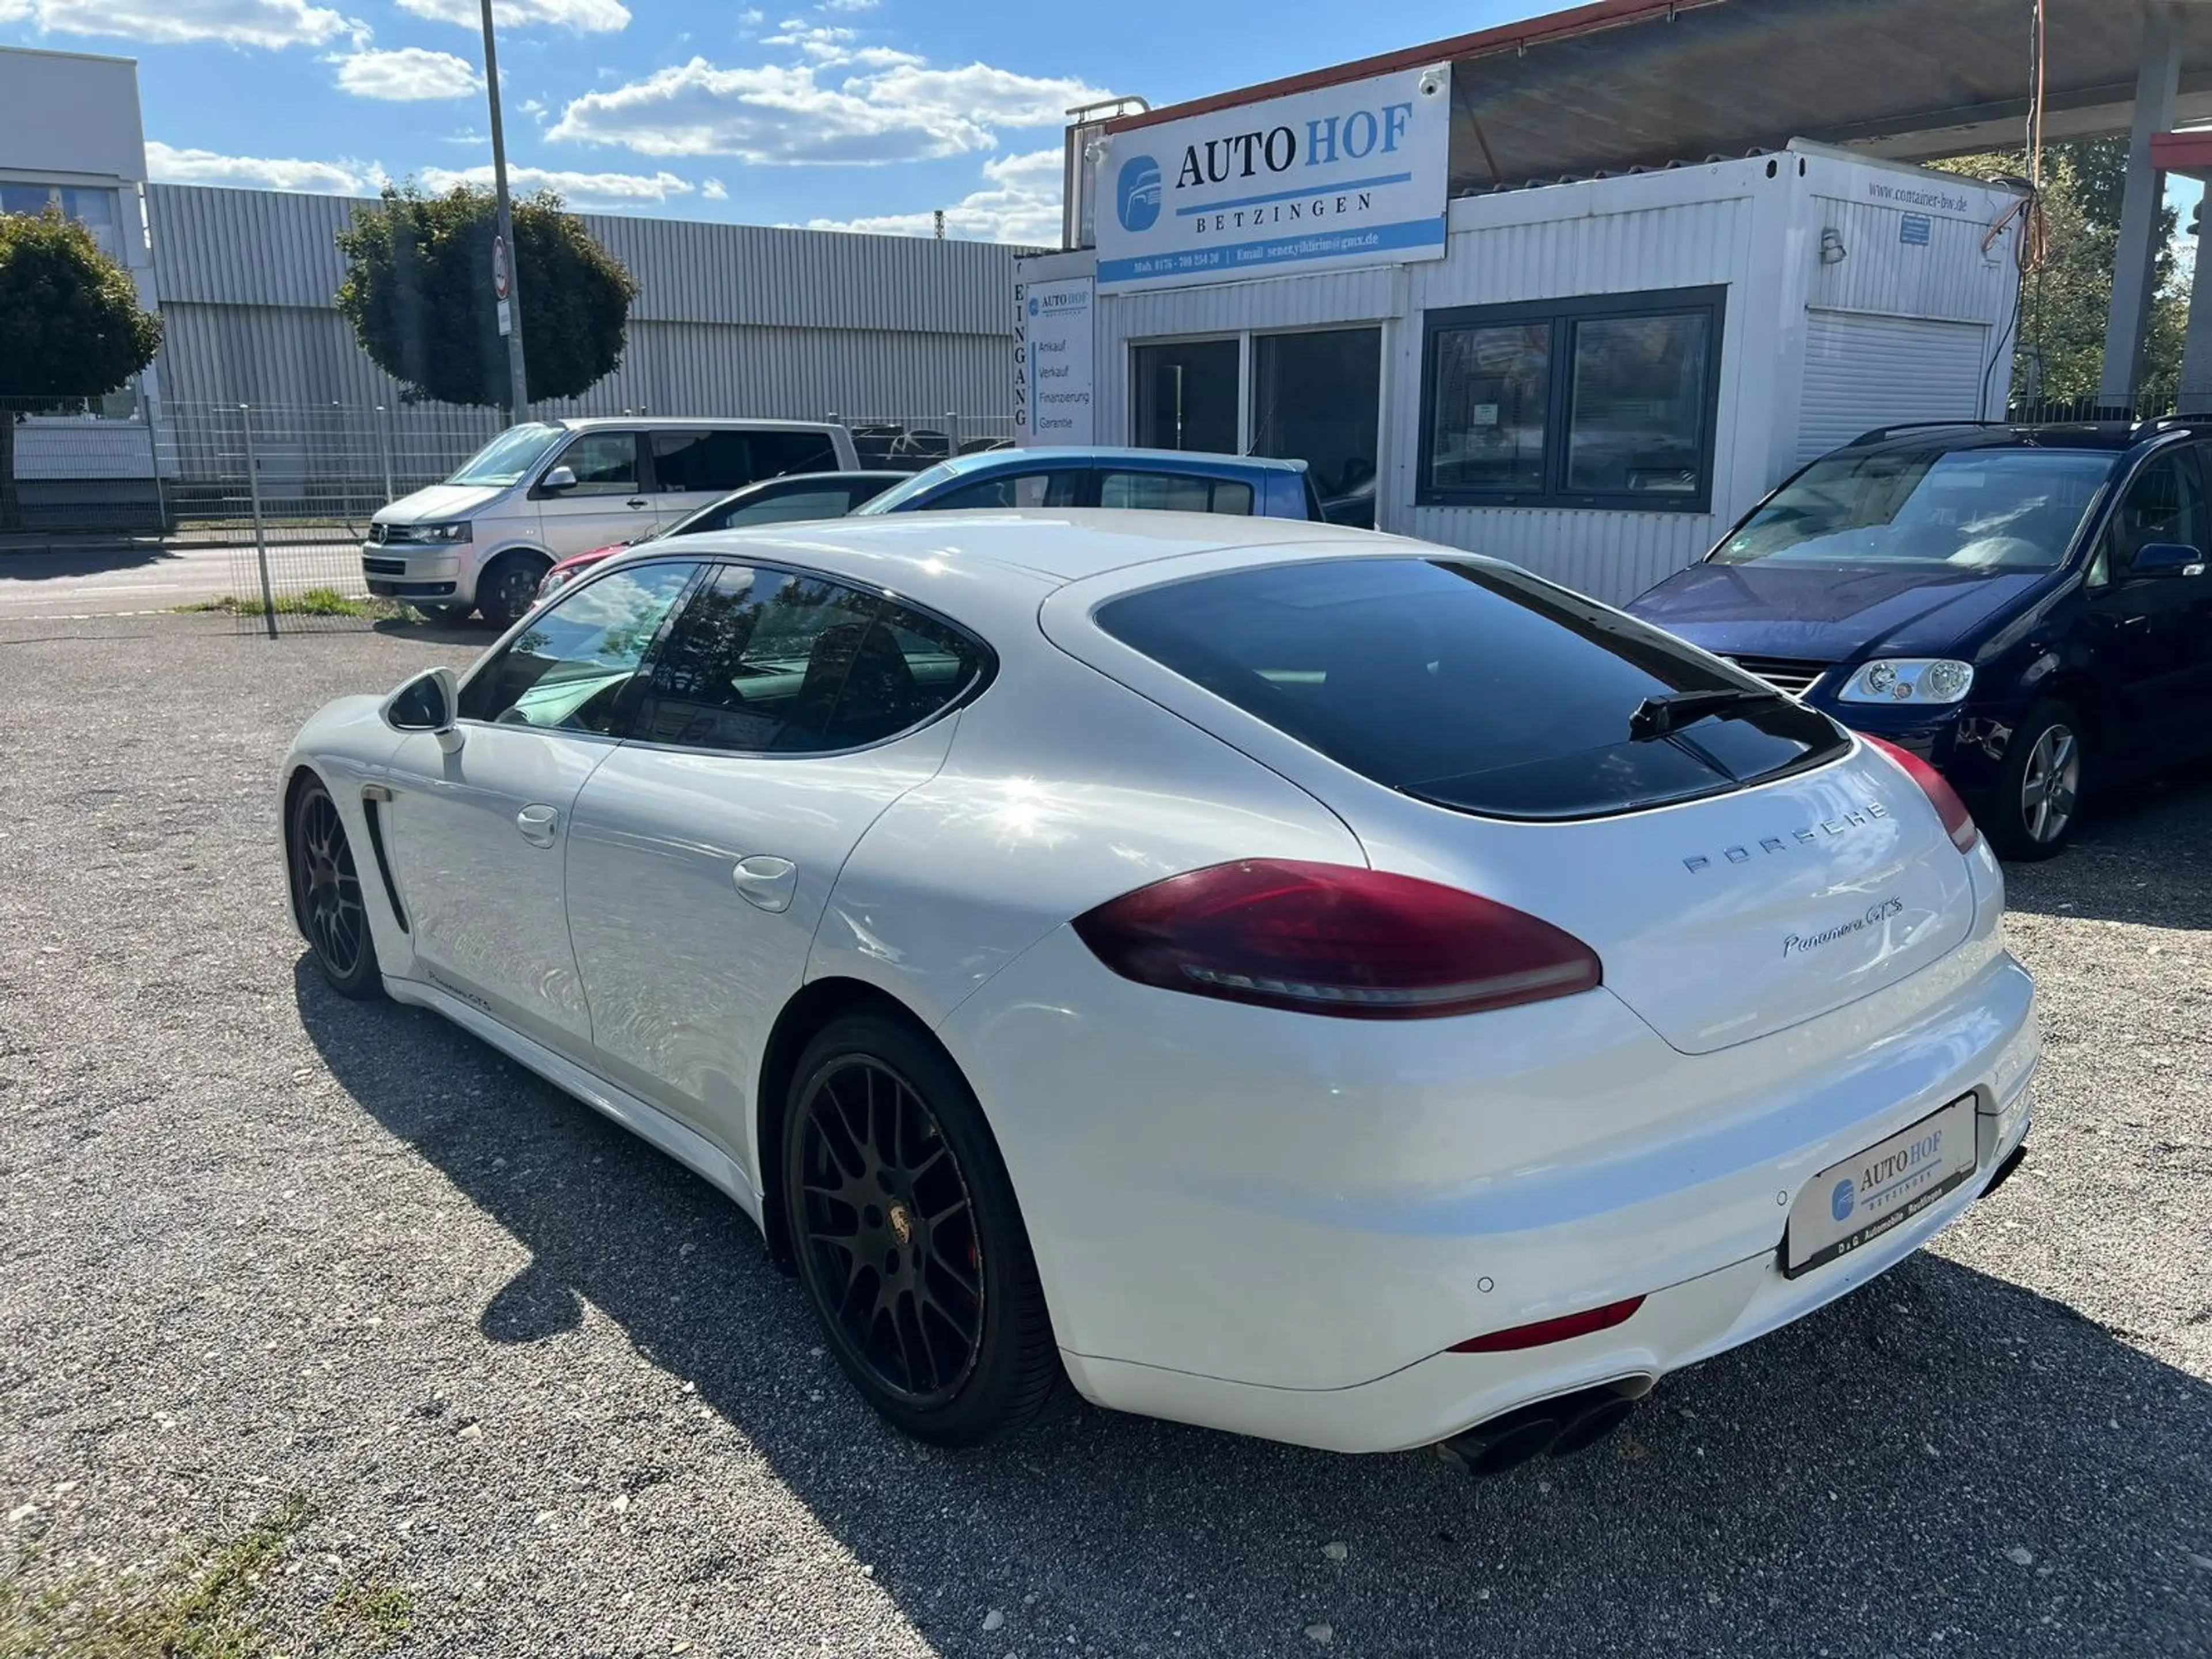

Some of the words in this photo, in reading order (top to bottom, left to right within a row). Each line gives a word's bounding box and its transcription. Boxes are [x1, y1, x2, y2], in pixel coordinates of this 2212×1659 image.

[1176, 126, 1296, 189] AUTO
[1305, 102, 1412, 166] HOF
[1196, 193, 1372, 233] BETZINGEN
[1869, 183, 1968, 211] www.container-bw.de
[1041, 294, 1067, 308] AUTO
[1068, 290, 1089, 304] HOF
[1014, 285, 1027, 426] EINGANG
[1039, 339, 1066, 352] Ankauf
[1039, 365, 1069, 380] Verkauf
[1039, 392, 1090, 405] Finanzierung
[1040, 417, 1073, 429] Garantie
[1683, 800, 1889, 874] PORSCHE
[1783, 919, 1865, 958] Panamera
[1865, 896, 1903, 927] GTS
[1861, 1149, 1908, 1193] AUTO
[1909, 1128, 1943, 1165] HOF
